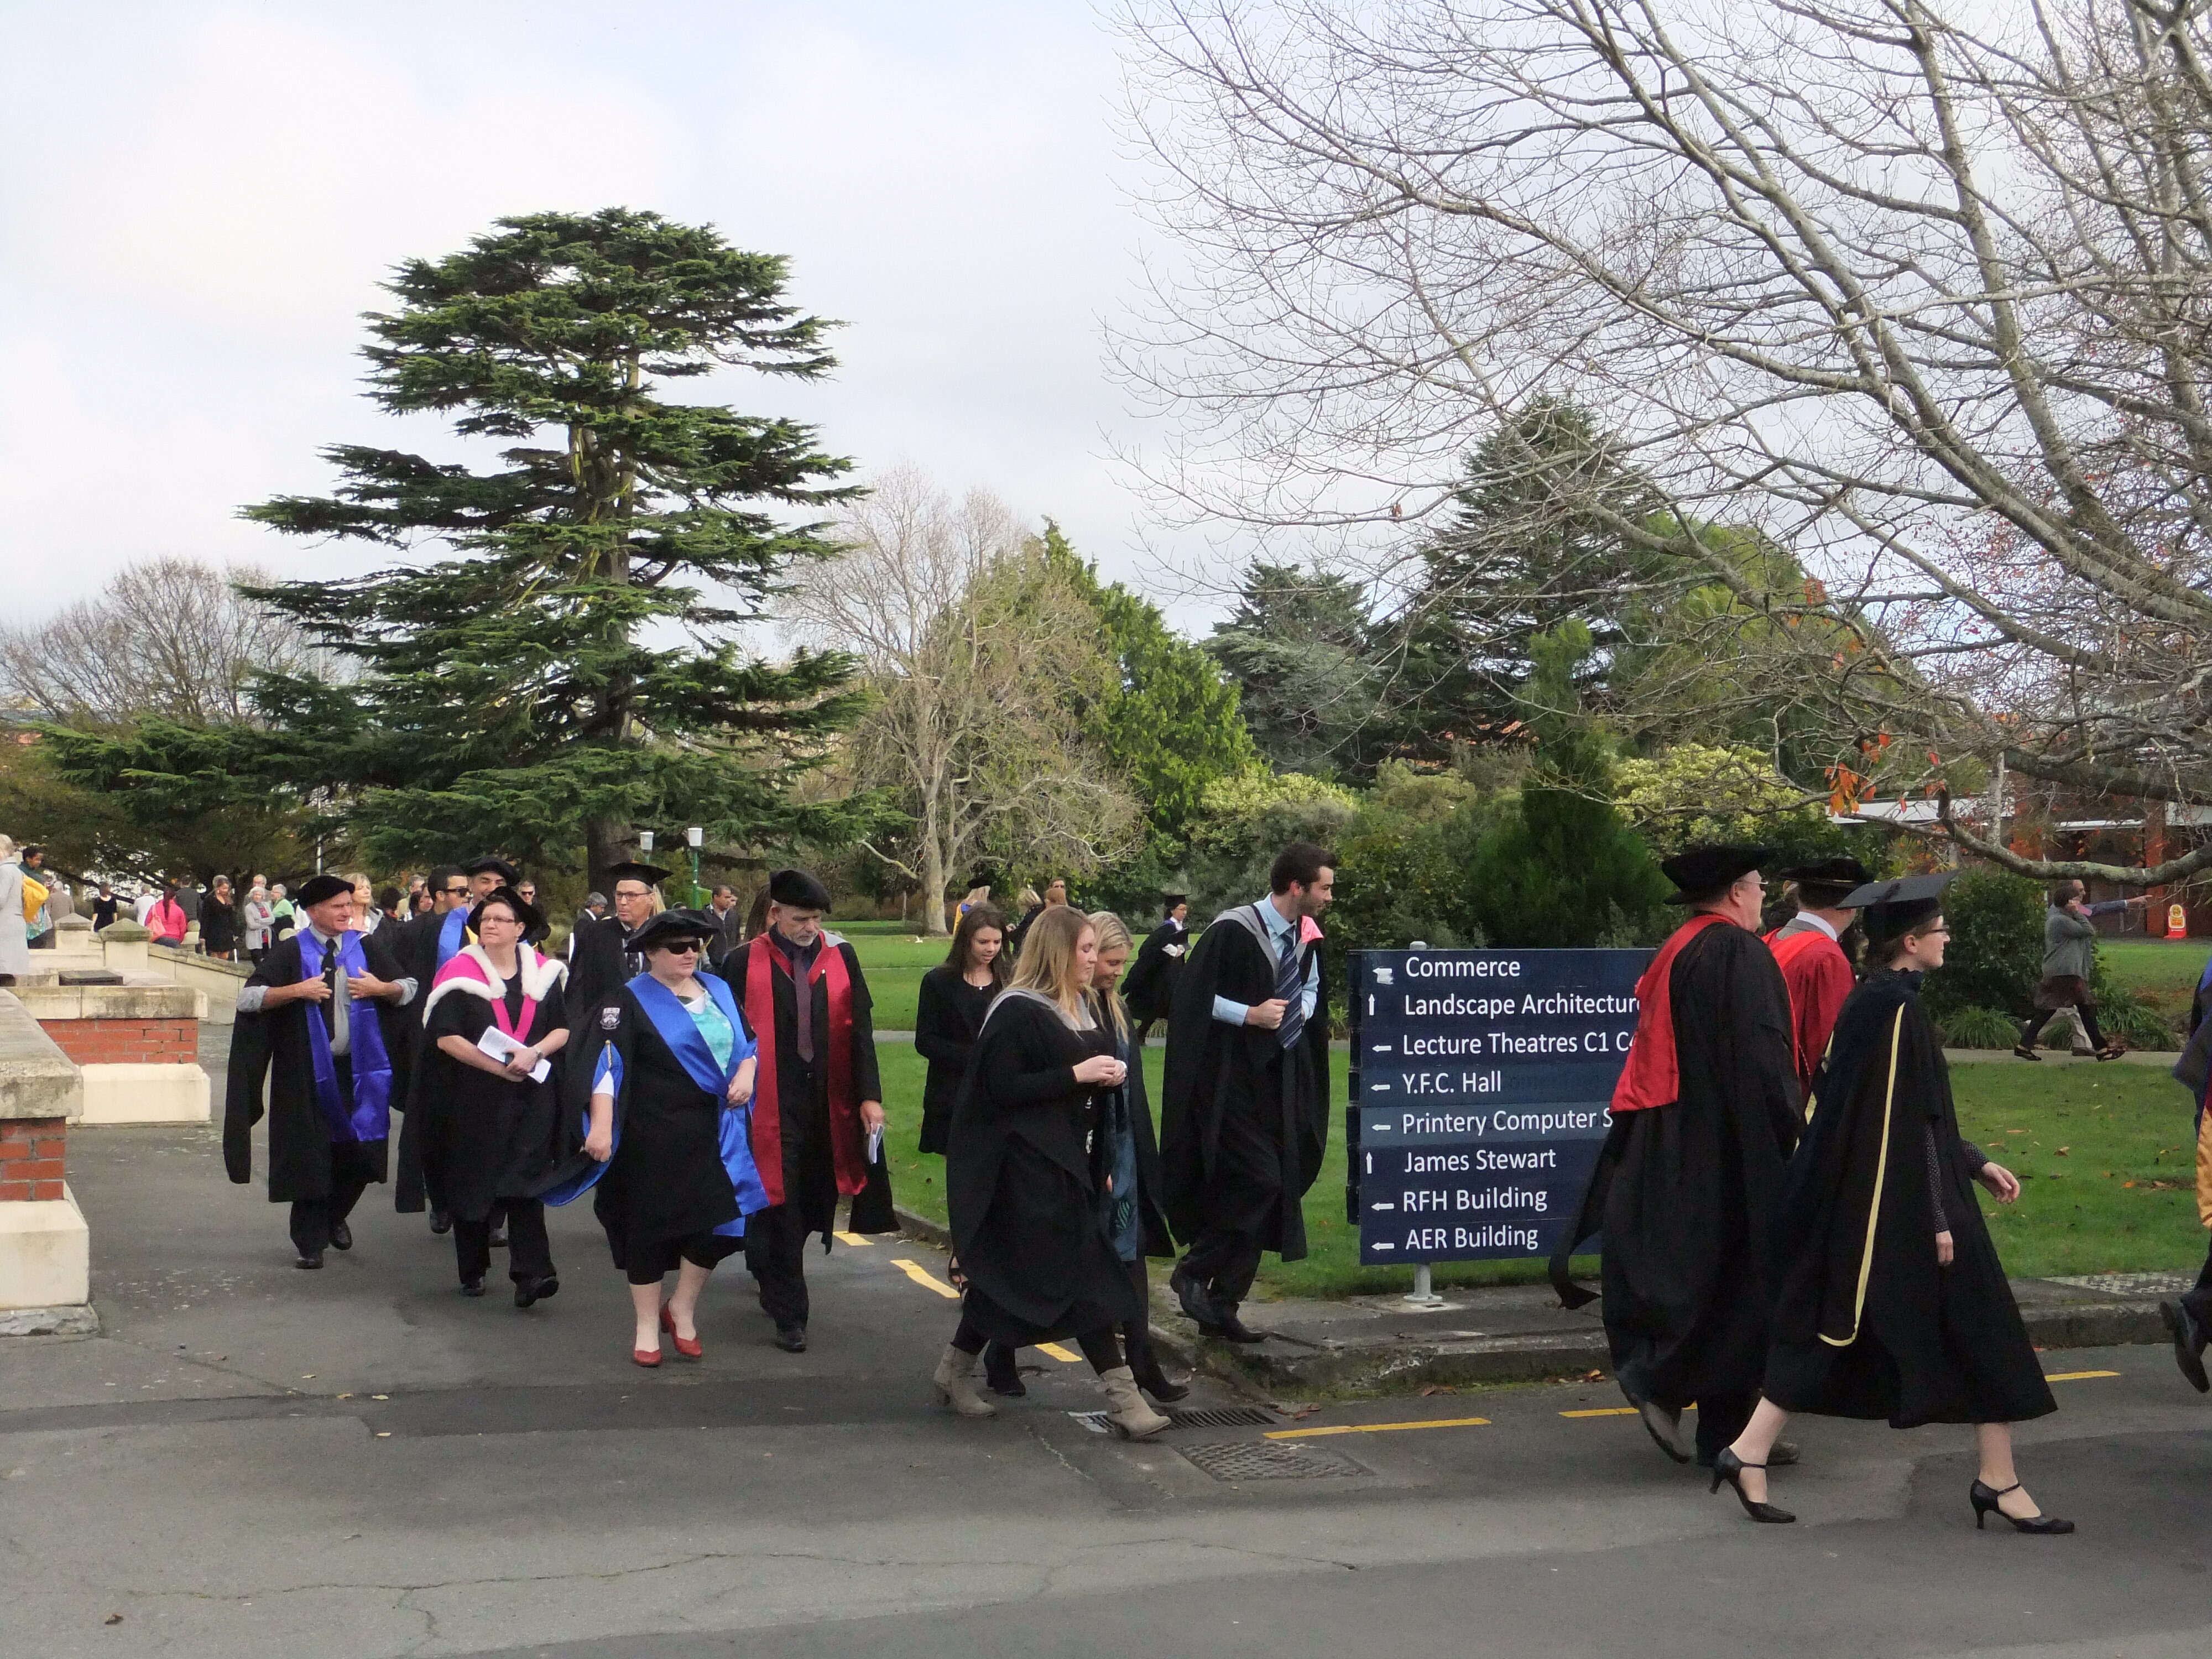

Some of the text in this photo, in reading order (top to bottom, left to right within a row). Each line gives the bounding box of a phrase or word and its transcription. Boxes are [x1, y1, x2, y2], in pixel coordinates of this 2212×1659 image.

[1406, 956, 1520, 977] Commerce
[1405, 992, 1640, 1019] Landscape Architectur
[1404, 1034, 1481, 1055] Lecture
[1488, 1032, 1578, 1053] Theatres
[1584, 1031, 1609, 1052] C1
[1402, 1070, 1501, 1094] Y.F.C. Hall
[1403, 1112, 1488, 1136] Printery
[1493, 1110, 1597, 1134] Computer
[1404, 1149, 1557, 1173] James Stewart
[1404, 1186, 1548, 1212] RFH Building
[1405, 1224, 1539, 1250] AER Building
